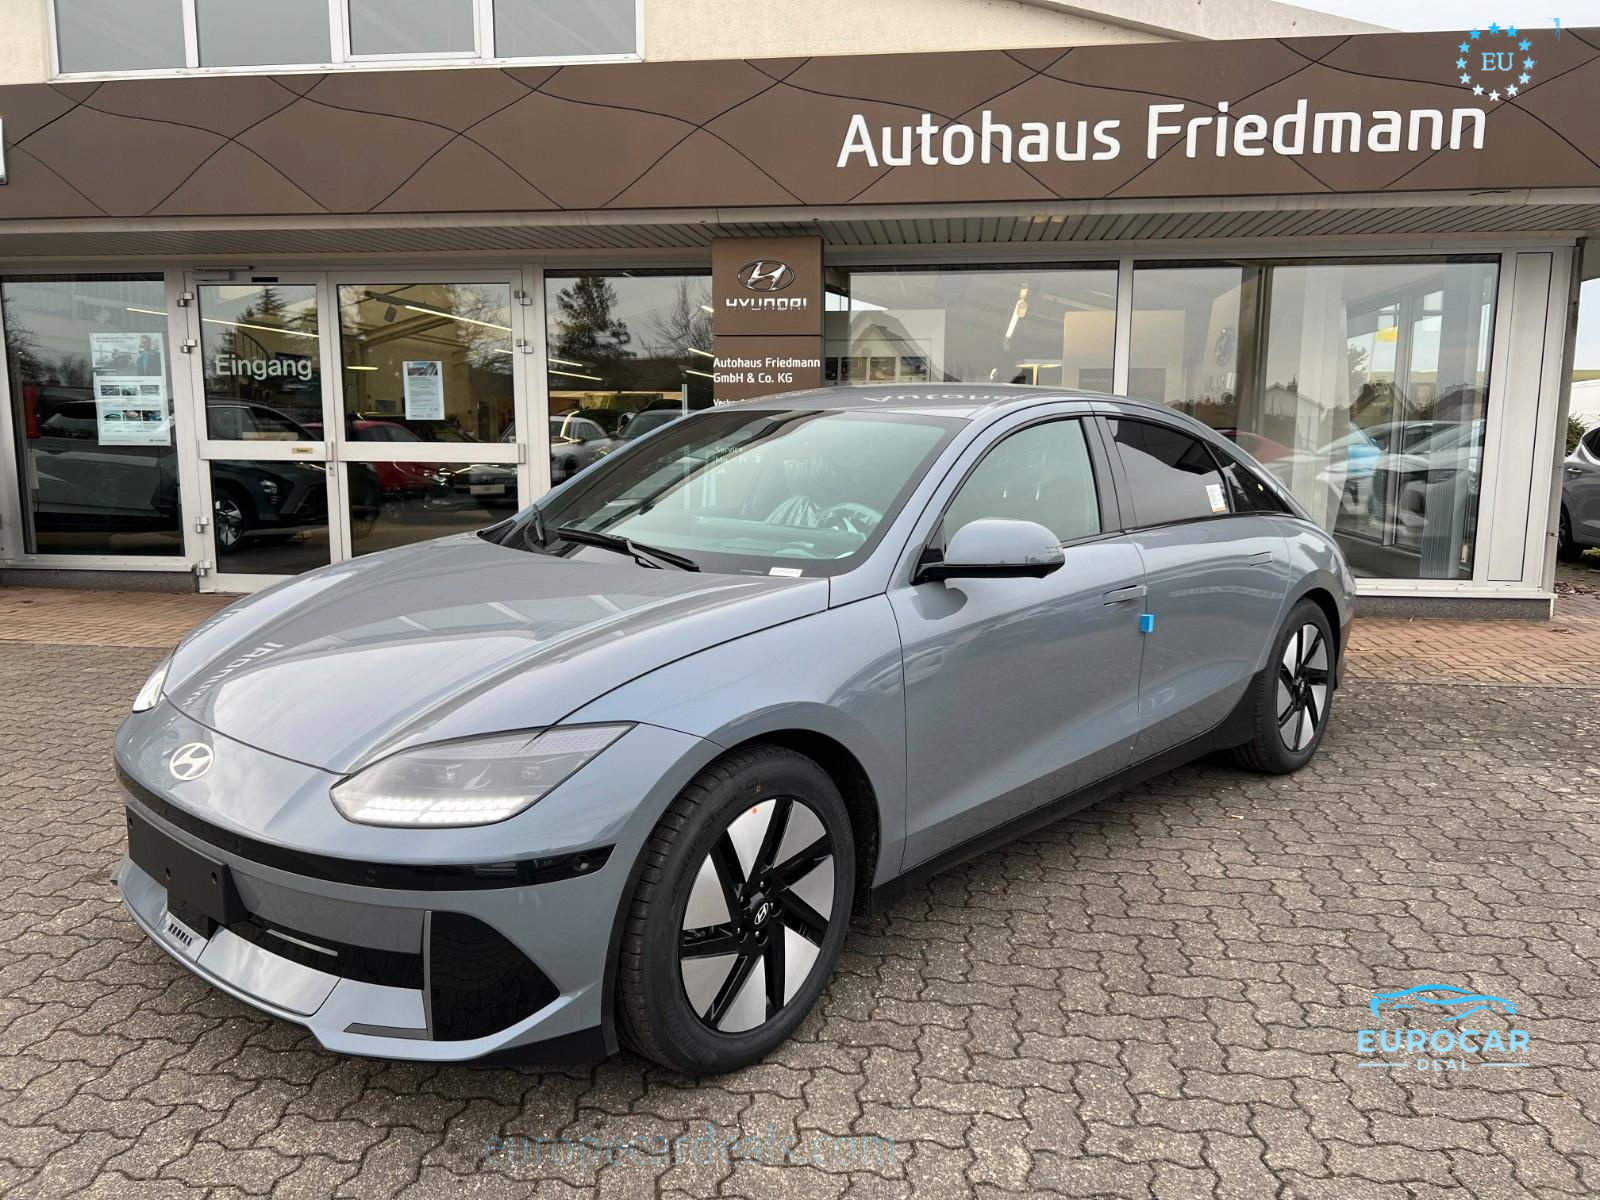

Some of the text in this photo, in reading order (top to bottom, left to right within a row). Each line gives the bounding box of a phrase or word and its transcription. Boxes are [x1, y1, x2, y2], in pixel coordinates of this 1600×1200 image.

[836, 98, 1486, 167] Autohaus Friedmann
[725, 297, 807, 311] HYUNDAI
[215, 353, 312, 381] Eingang
[712, 357, 821, 368] Autohaus Friedmann
[713, 372, 793, 383] GmbH & Co. KG
